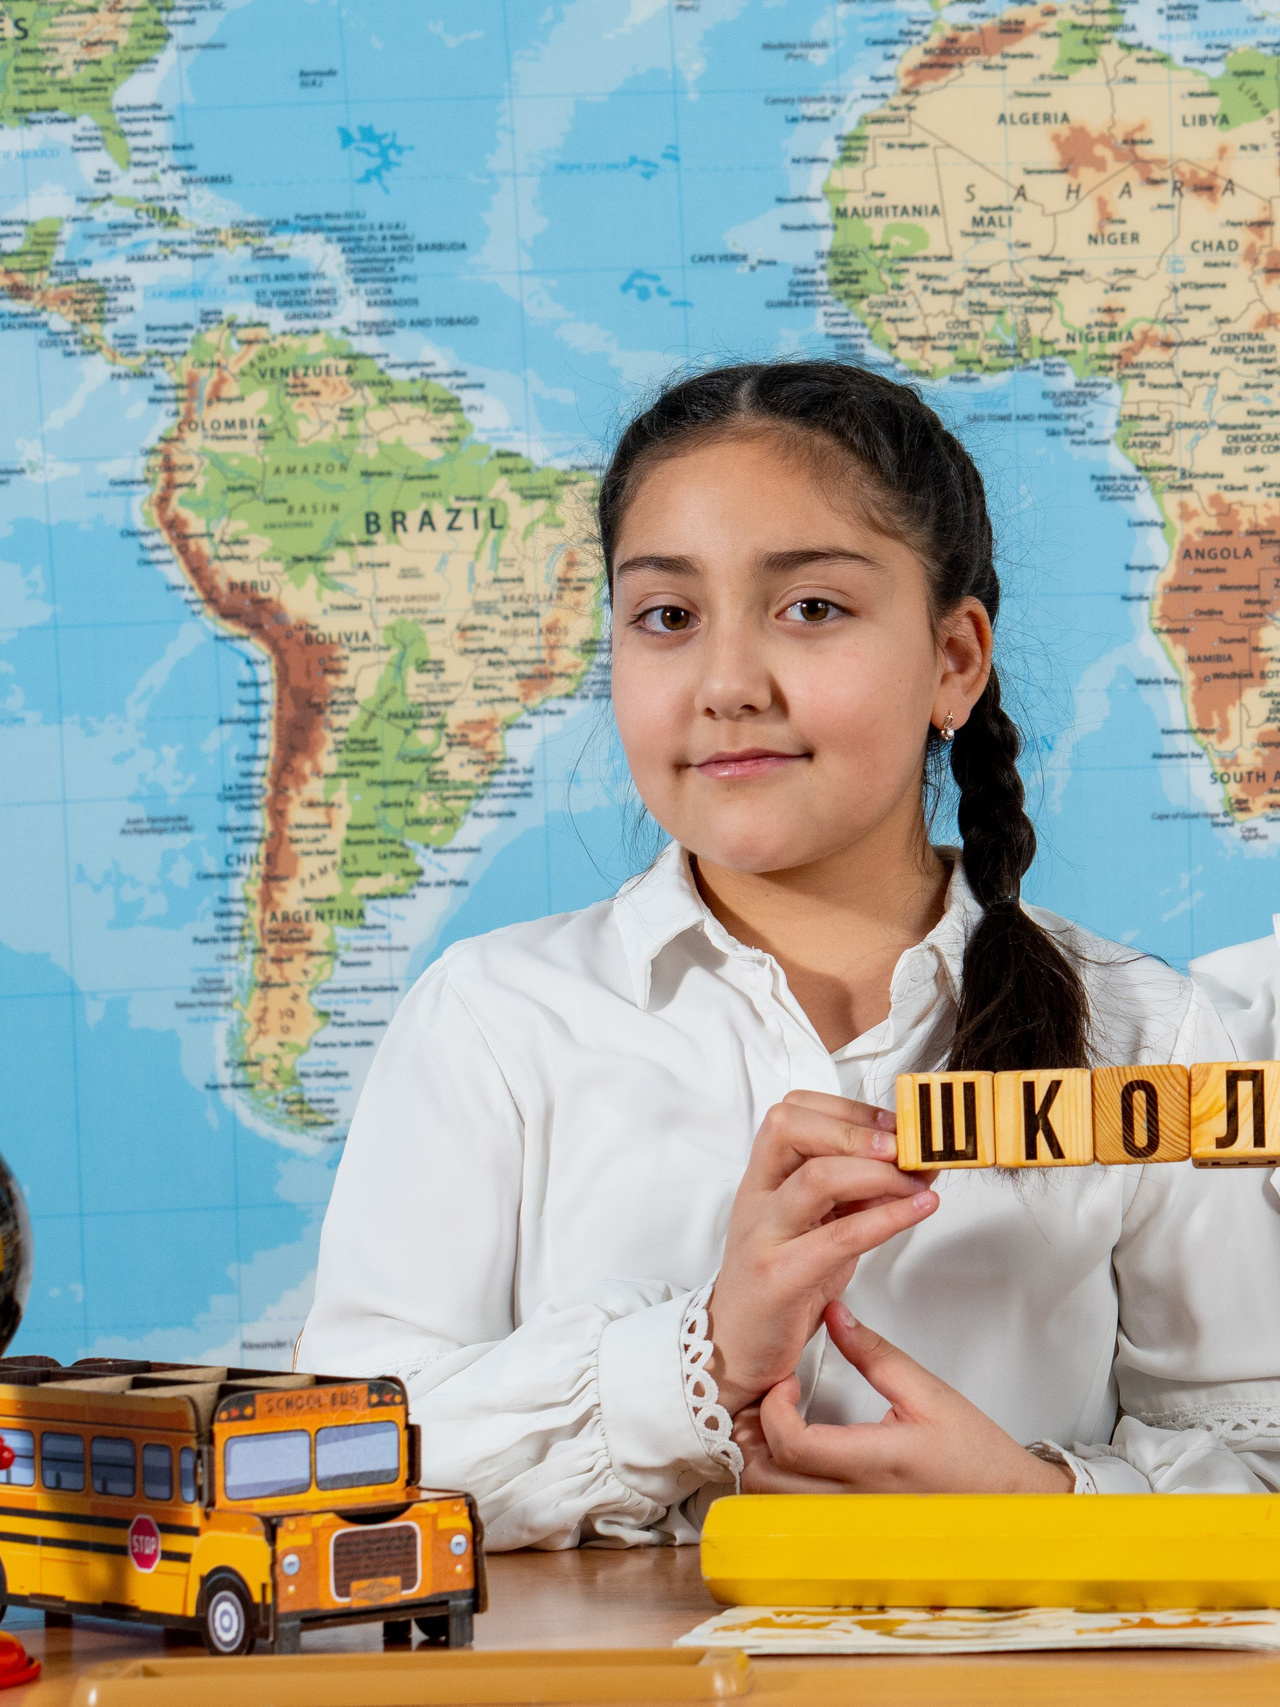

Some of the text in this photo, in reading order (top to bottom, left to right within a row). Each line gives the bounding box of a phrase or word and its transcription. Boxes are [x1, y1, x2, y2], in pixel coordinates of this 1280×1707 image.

[999, 112, 1070, 126] ALGERIA
[1182, 114, 1230, 127] LIBYA
[966, 179, 1236, 201] SAHARA
[135, 207, 179, 219] CUBA
[836, 205, 940, 219] MAURITANIA
[972, 216, 1012, 228] MALI
[1088, 232, 1139, 245] NIGER
[1191, 241, 1238, 252] CHAD
[1067, 332, 1134, 343] NIGERIA
[259, 365, 354, 379] VENEZUELA
[178, 419, 266, 432] COLOMBIA
[274, 464, 348, 477] AMAZON
[287, 504, 339, 515] BASIN
[365, 508, 504, 534] BRAZIL
[1183, 548, 1253, 560] ANGOLA
[230, 581, 270, 593] PERU
[305, 632, 371, 645] BOLIVIA
[1188, 655, 1233, 663] NAMIBIA
[1211, 771, 1266, 784] SOUTH
[225, 854, 272, 866] CHILE
[270, 910, 365, 923] ARGENTINA
[267, 1390, 358, 1413] SCHOOL BUS
[129, 1535, 157, 1555] STOP
